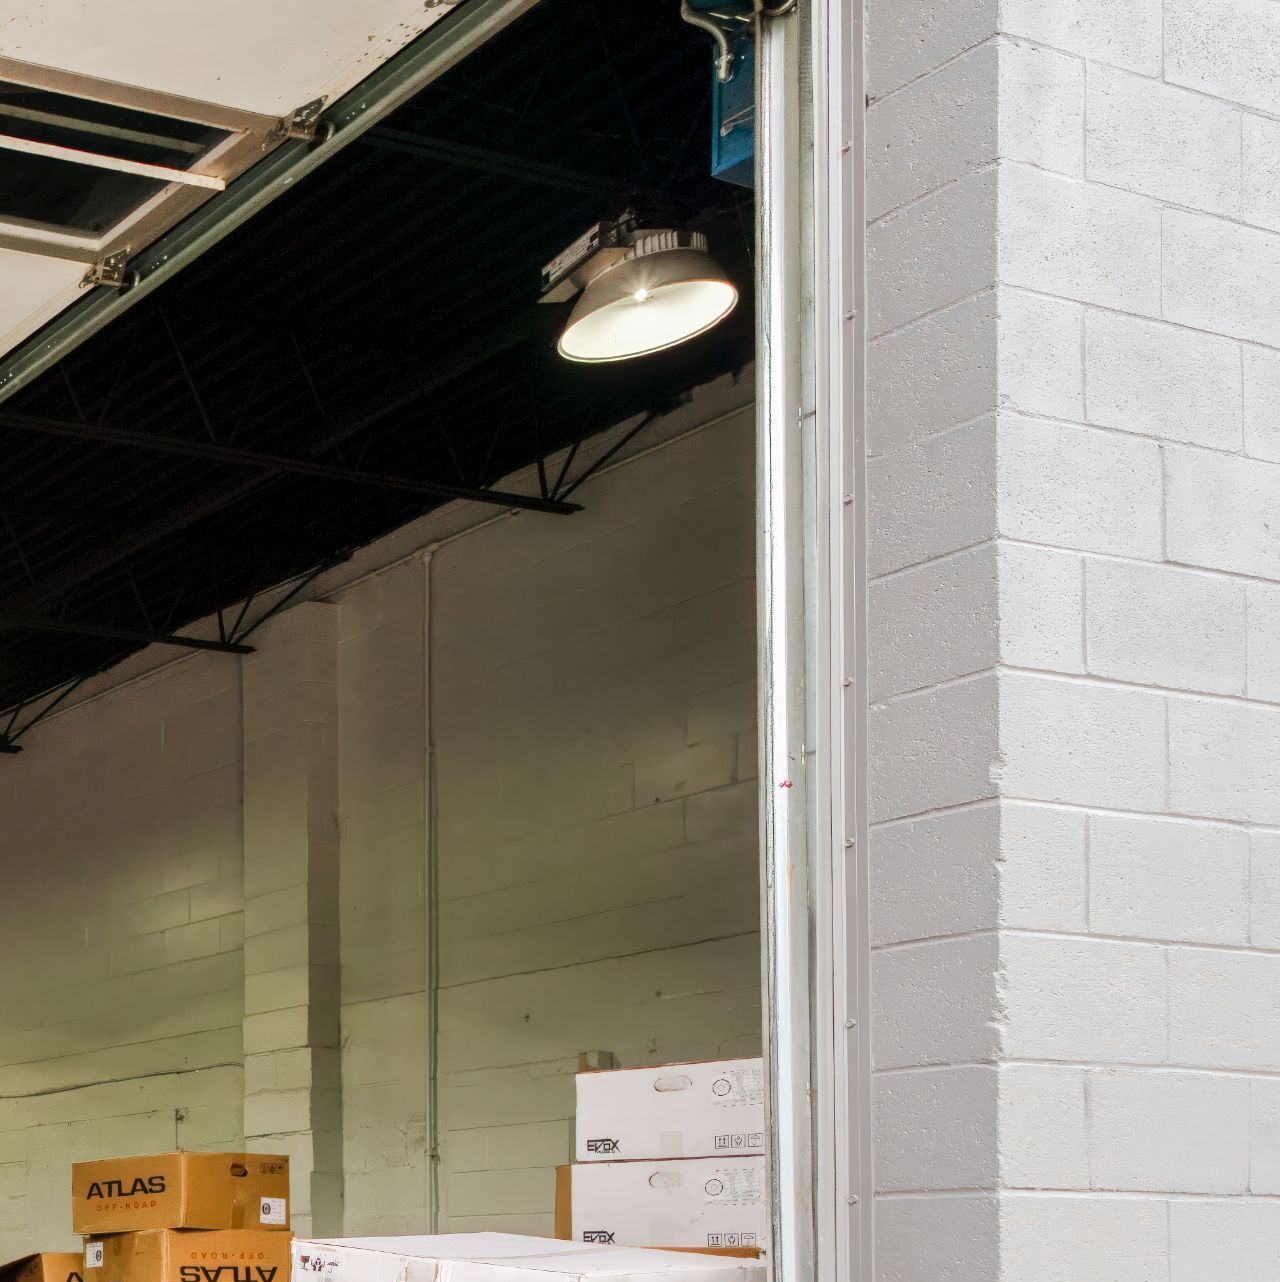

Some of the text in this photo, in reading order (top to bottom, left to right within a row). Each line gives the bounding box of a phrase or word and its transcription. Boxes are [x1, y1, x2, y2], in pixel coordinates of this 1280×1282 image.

[87, 1176, 166, 1200] ATLAS
[96, 1200, 157, 1212] OFF-ROAD
[191, 1251, 264, 1260] OFF-ROAD
